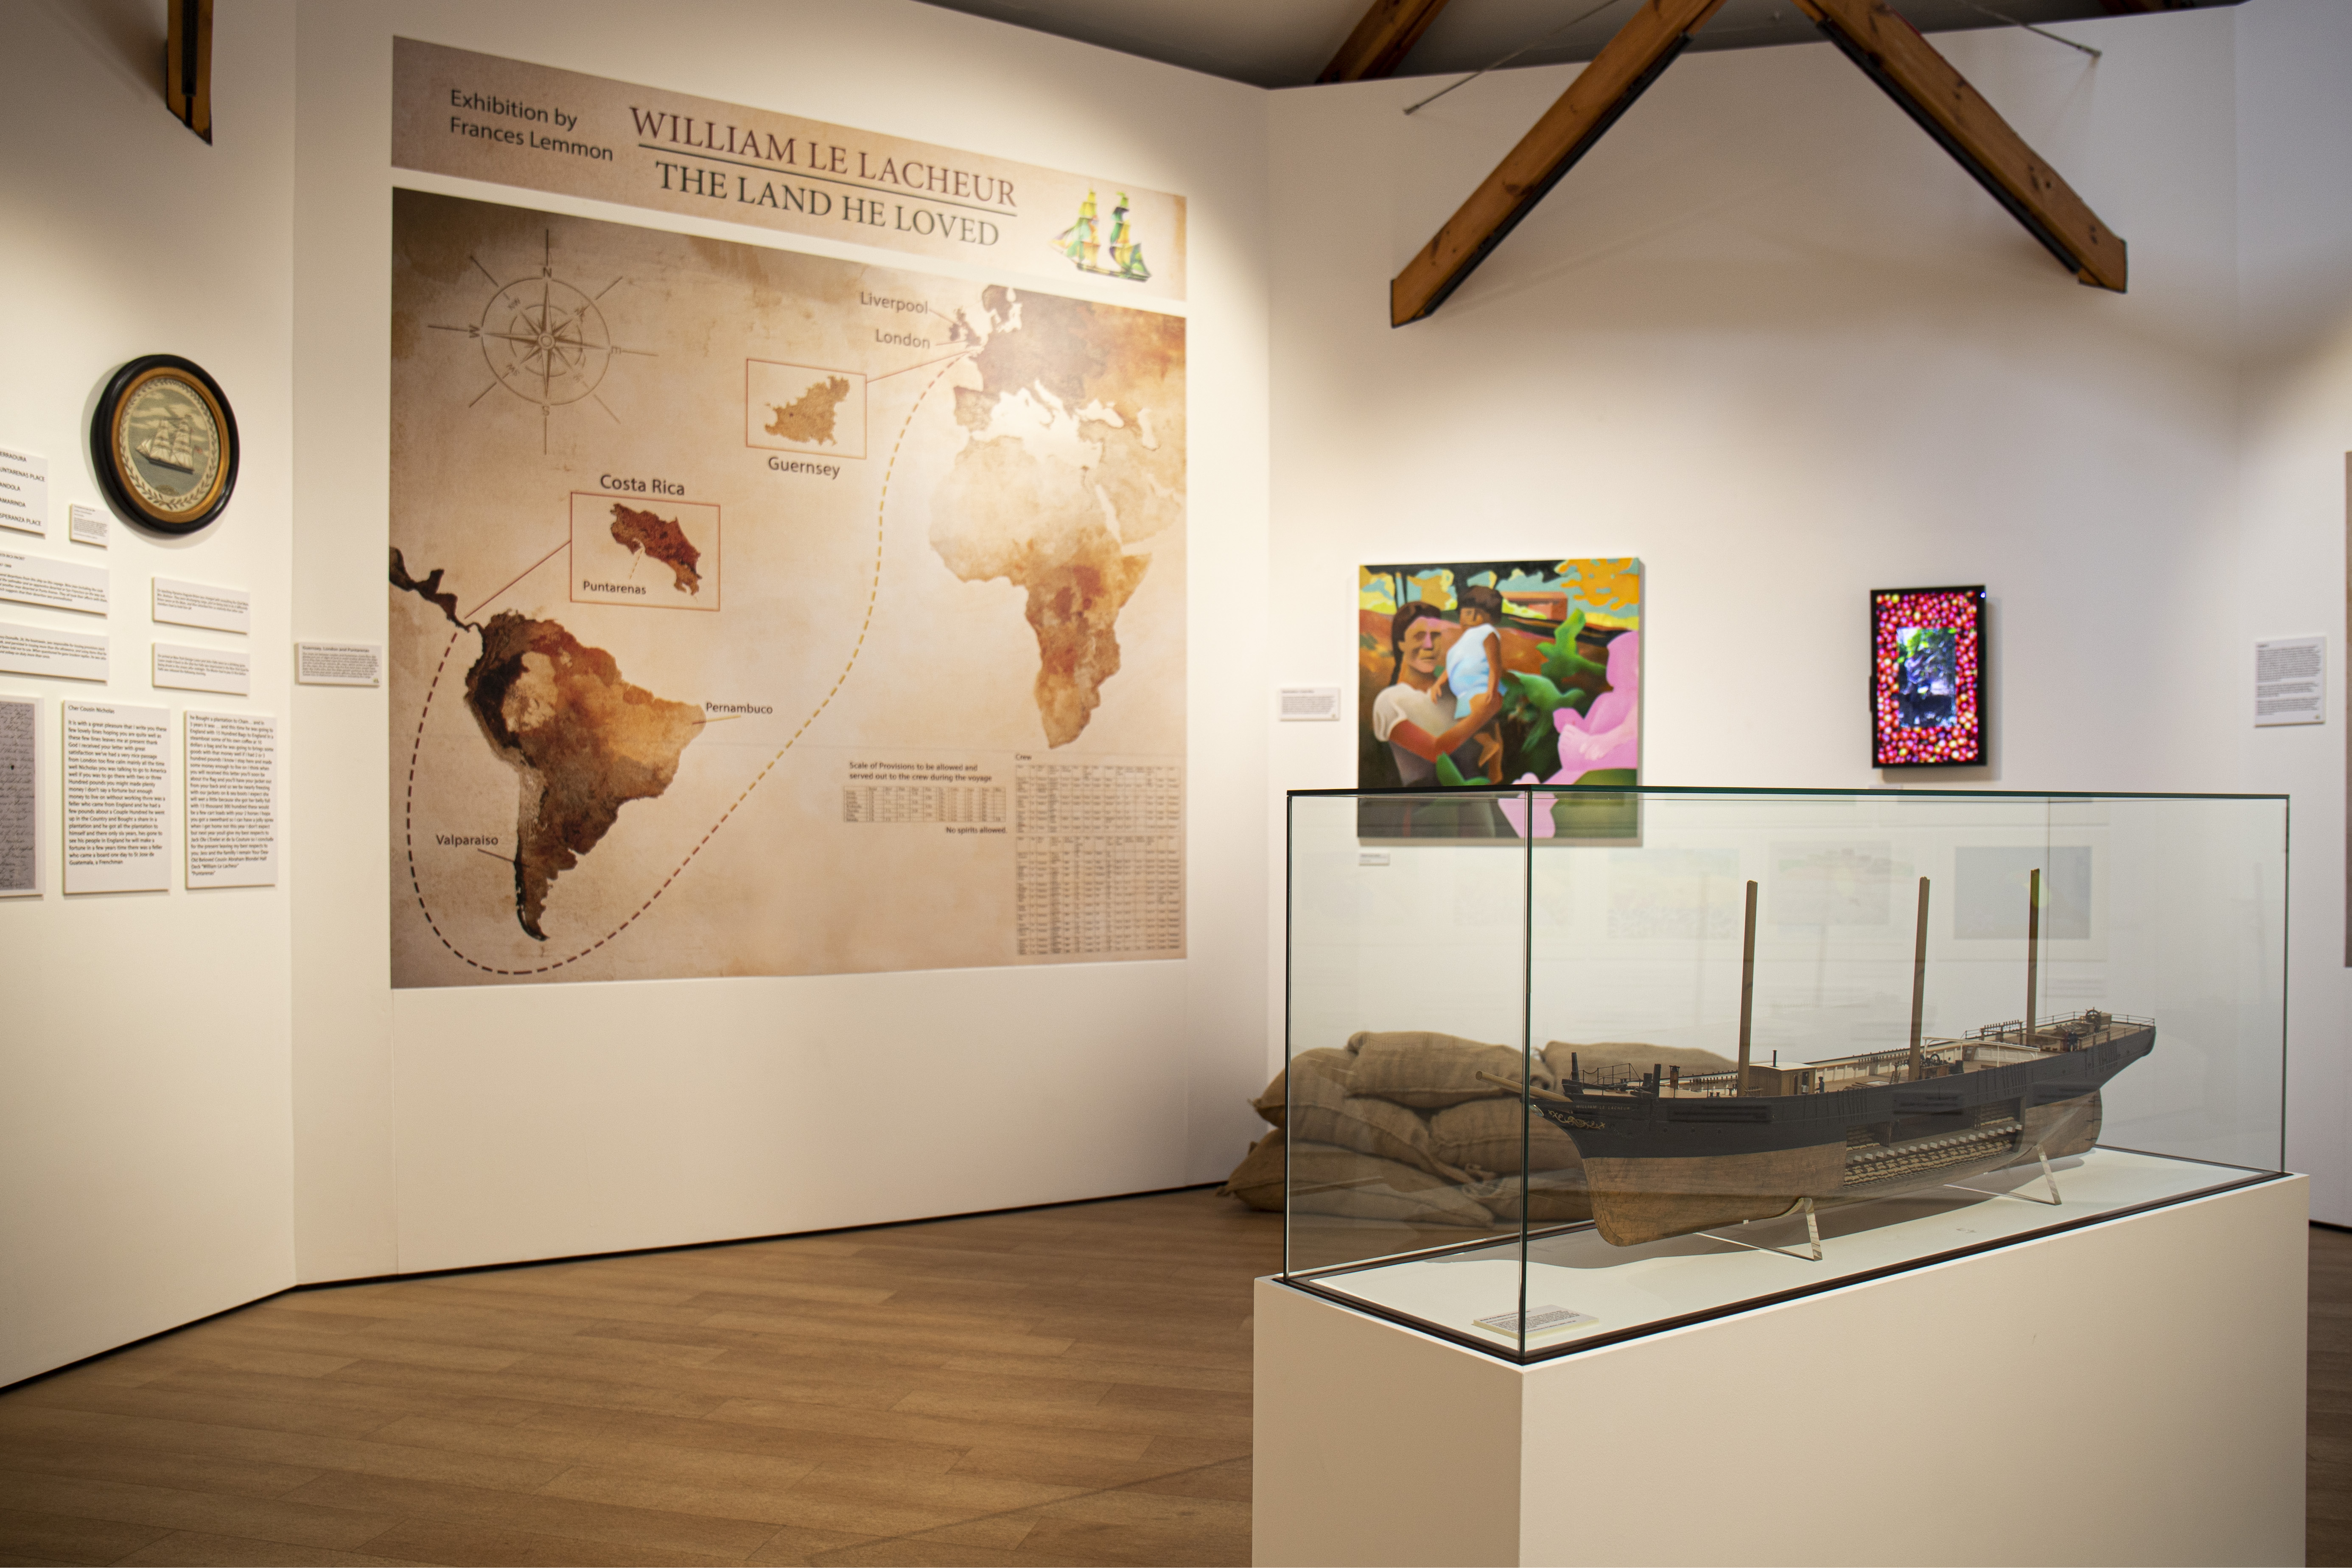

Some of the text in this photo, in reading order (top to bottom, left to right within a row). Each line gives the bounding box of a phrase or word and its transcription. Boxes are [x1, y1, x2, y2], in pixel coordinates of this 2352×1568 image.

[450, 89, 577, 132] Exhibition by
[450, 116, 613, 162] Frances Lemmon
[630, 106, 1017, 207] WILLIAM LE LACHEUR
[655, 161, 999, 246] THE LAND HE LOVED
[543, 267, 552, 278] N
[860, 291, 928, 315] Liverpool
[469, 325, 480, 338] W
[876, 329, 931, 350] London
[542, 406, 550, 416] S
[768, 456, 840, 480] Guernsey
[30, 473, 45, 482] PLACE
[600, 474, 685, 496] Costa Rica
[583, 581, 647, 595] Puntarenas
[706, 702, 773, 714] Pernambuco
[931, 773, 953, 782] during
[958, 826, 977, 835] spirits
[436, 834, 498, 847] Valparaiso
